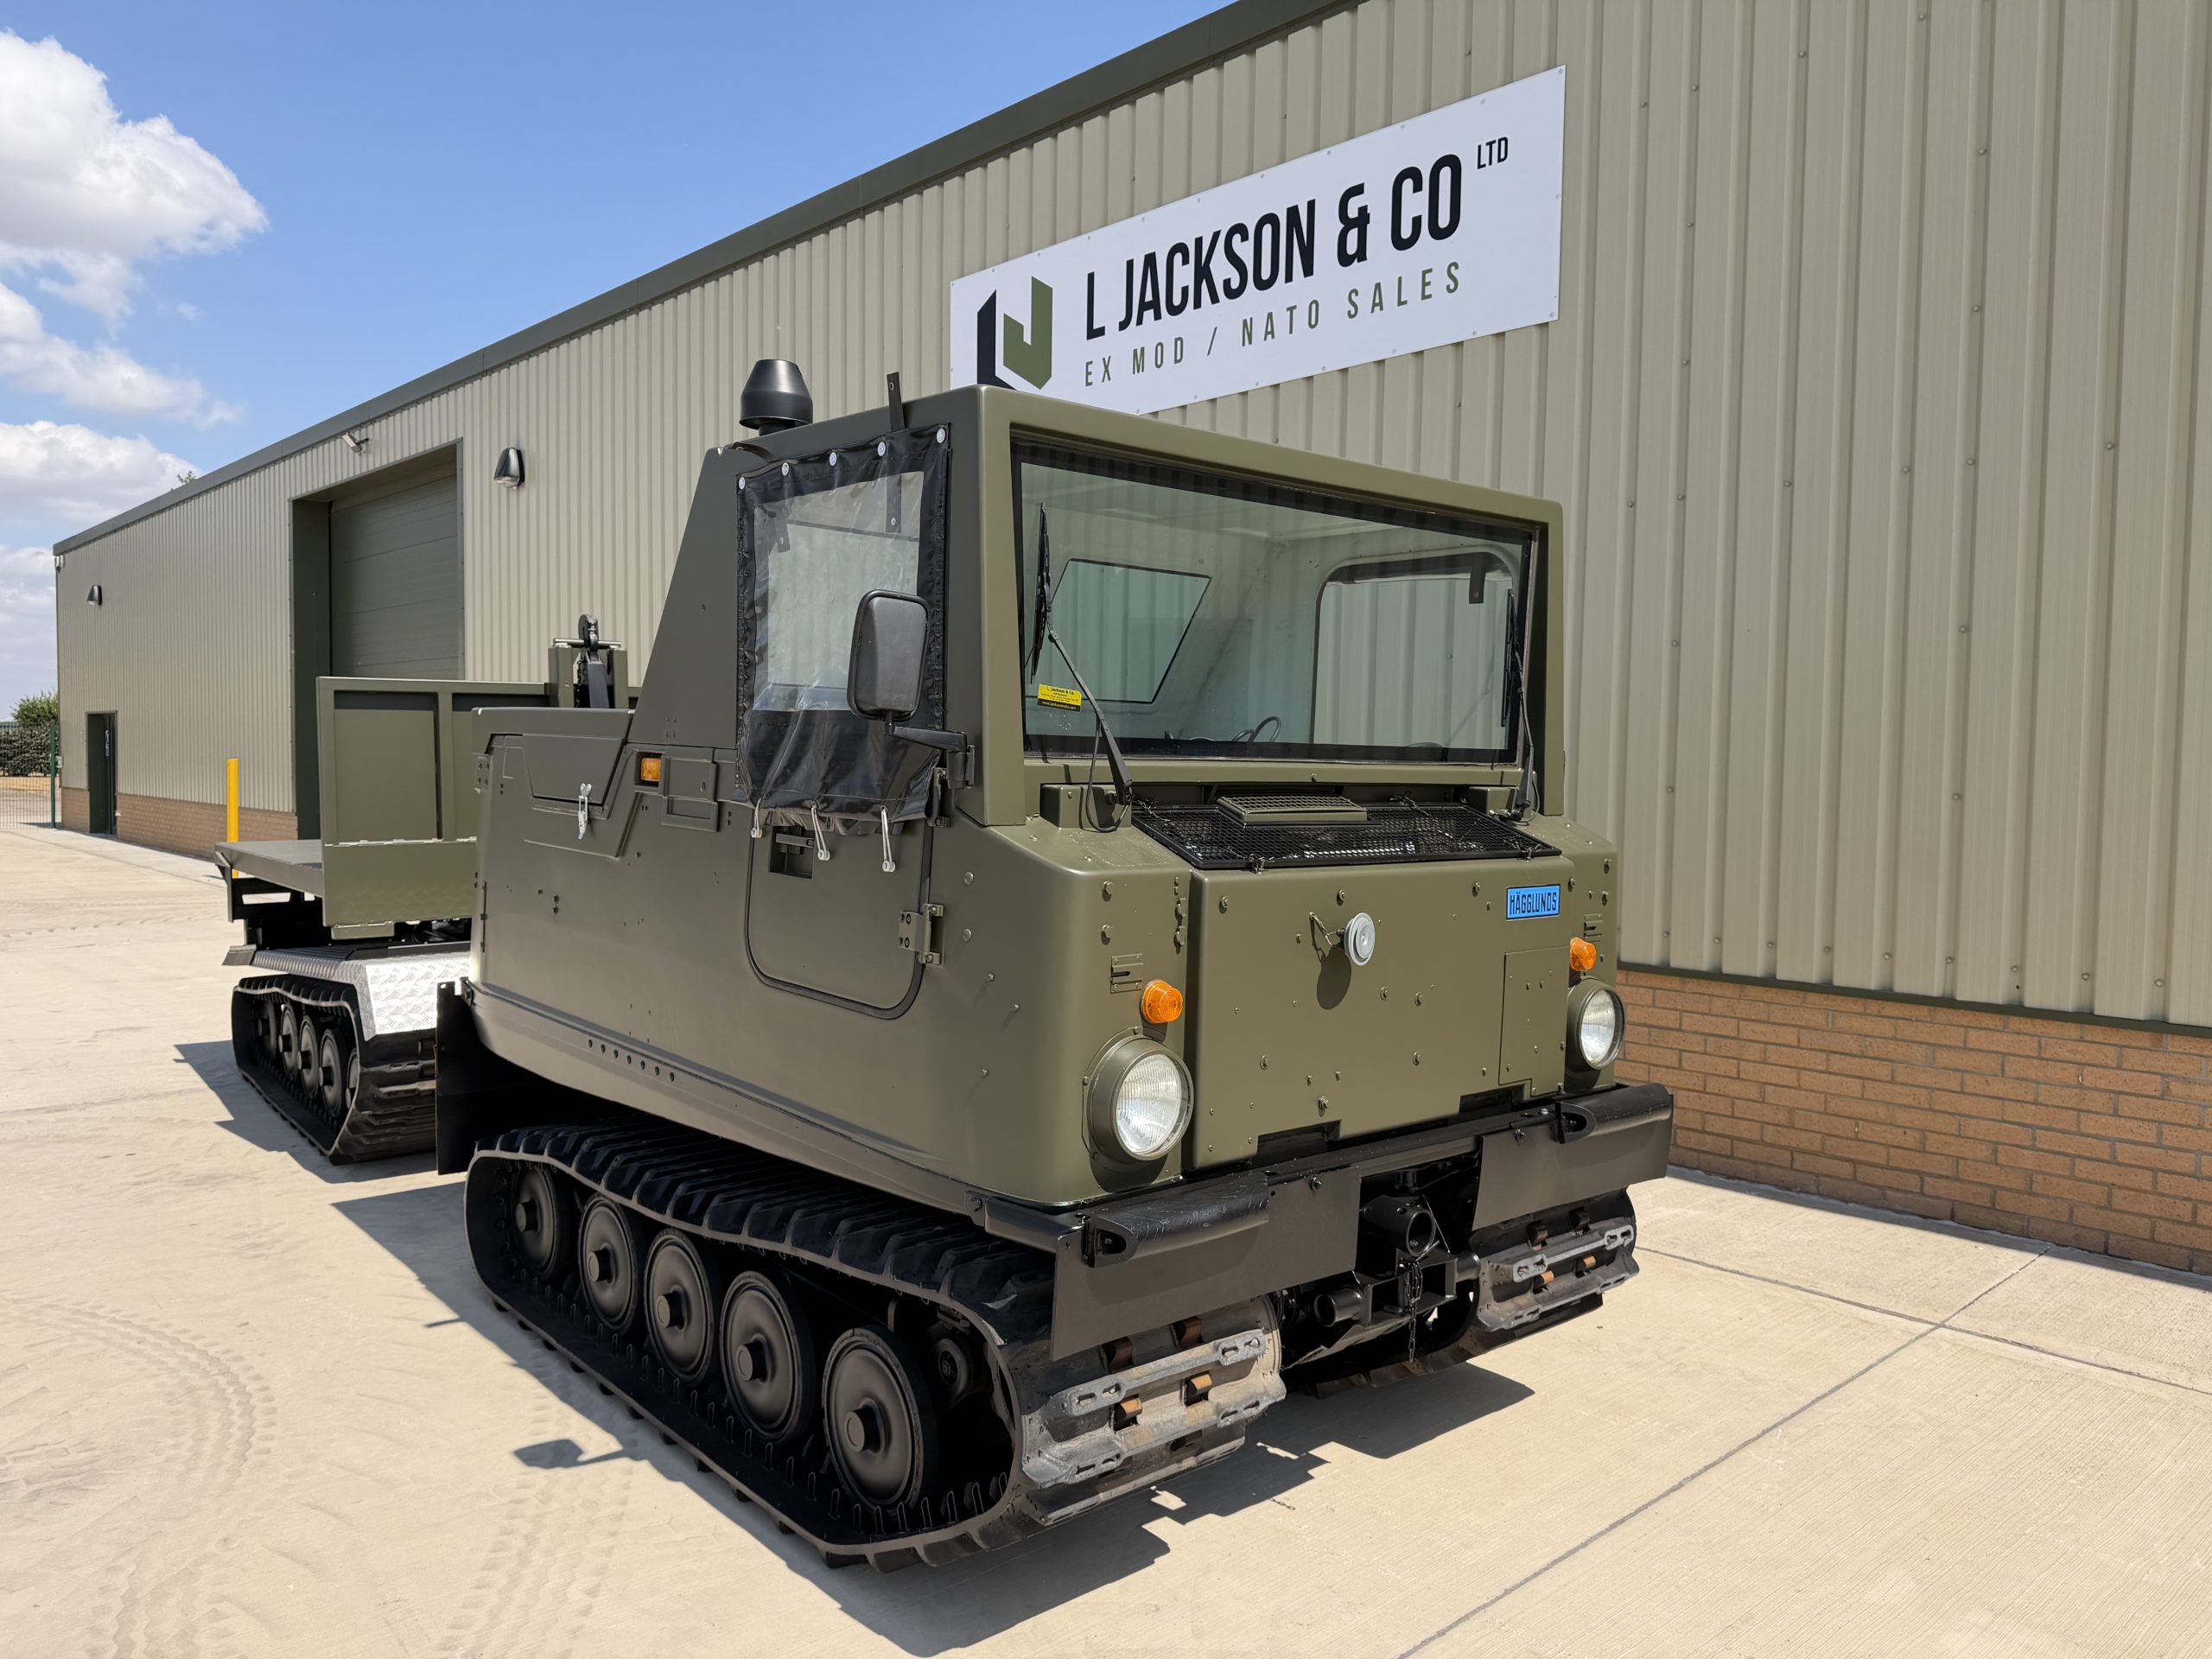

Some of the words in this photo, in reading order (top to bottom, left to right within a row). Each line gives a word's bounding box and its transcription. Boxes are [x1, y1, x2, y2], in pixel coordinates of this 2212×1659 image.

[1086, 271, 1105, 340] L
[1118, 199, 1316, 332] JACKSON
[1337, 182, 1370, 268] &
[1390, 154, 1462, 251] CO
[1477, 137, 1509, 170] LTD
[1085, 355, 1111, 387] EX
[1132, 336, 1184, 375] MOD
[1206, 326, 1217, 357] /
[1242, 299, 1319, 346] NATO
[1347, 261, 1459, 319] SALES
[1510, 892, 1557, 915] HÄGGLUNDS
